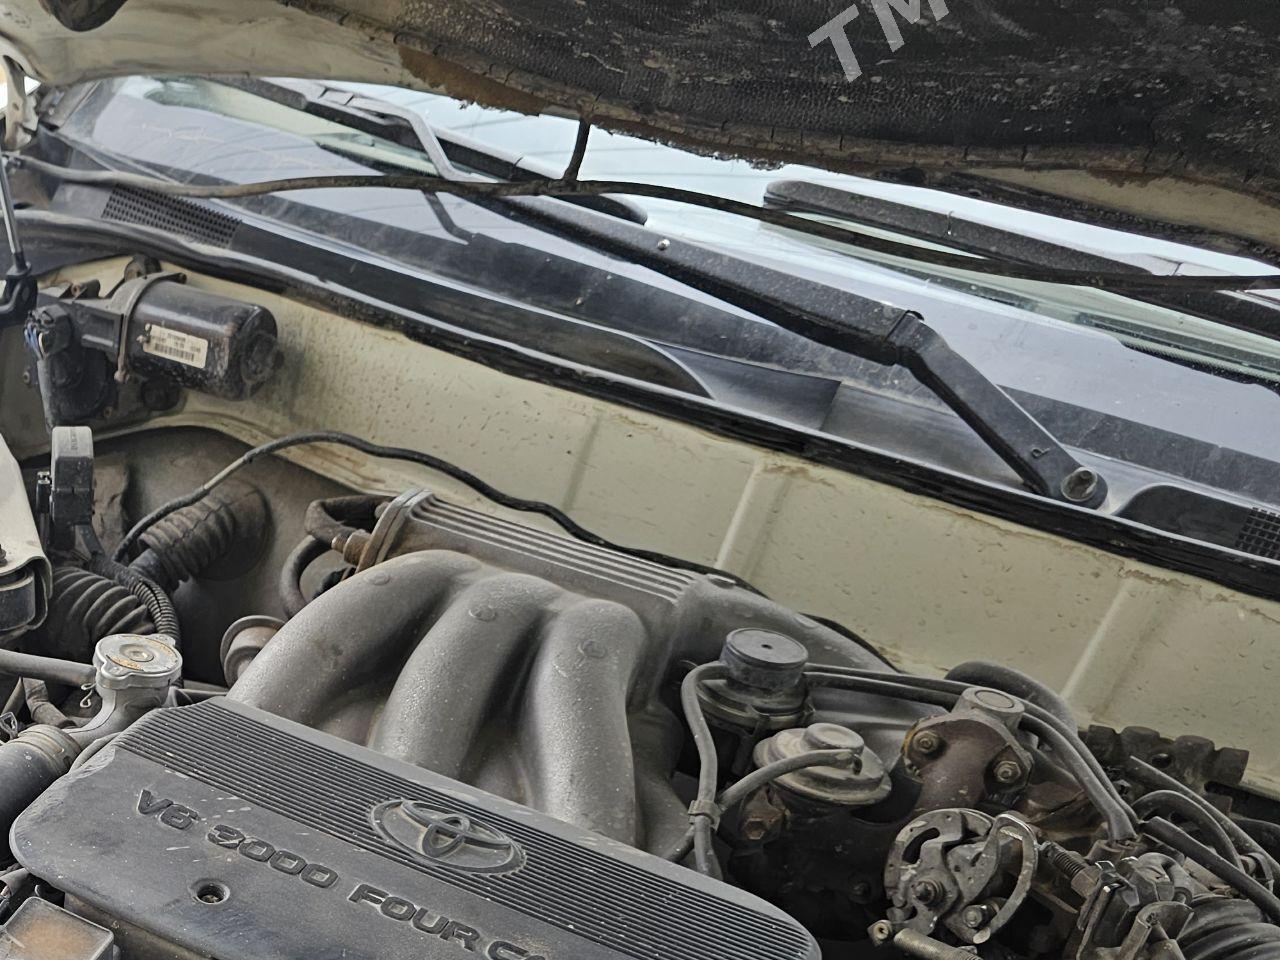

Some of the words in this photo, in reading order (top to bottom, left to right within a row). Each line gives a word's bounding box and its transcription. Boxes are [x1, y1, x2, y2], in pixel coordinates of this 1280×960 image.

[137, 788, 201, 831] V6
[206, 823, 341, 889] 3000
[347, 883, 482, 953] FOUR
